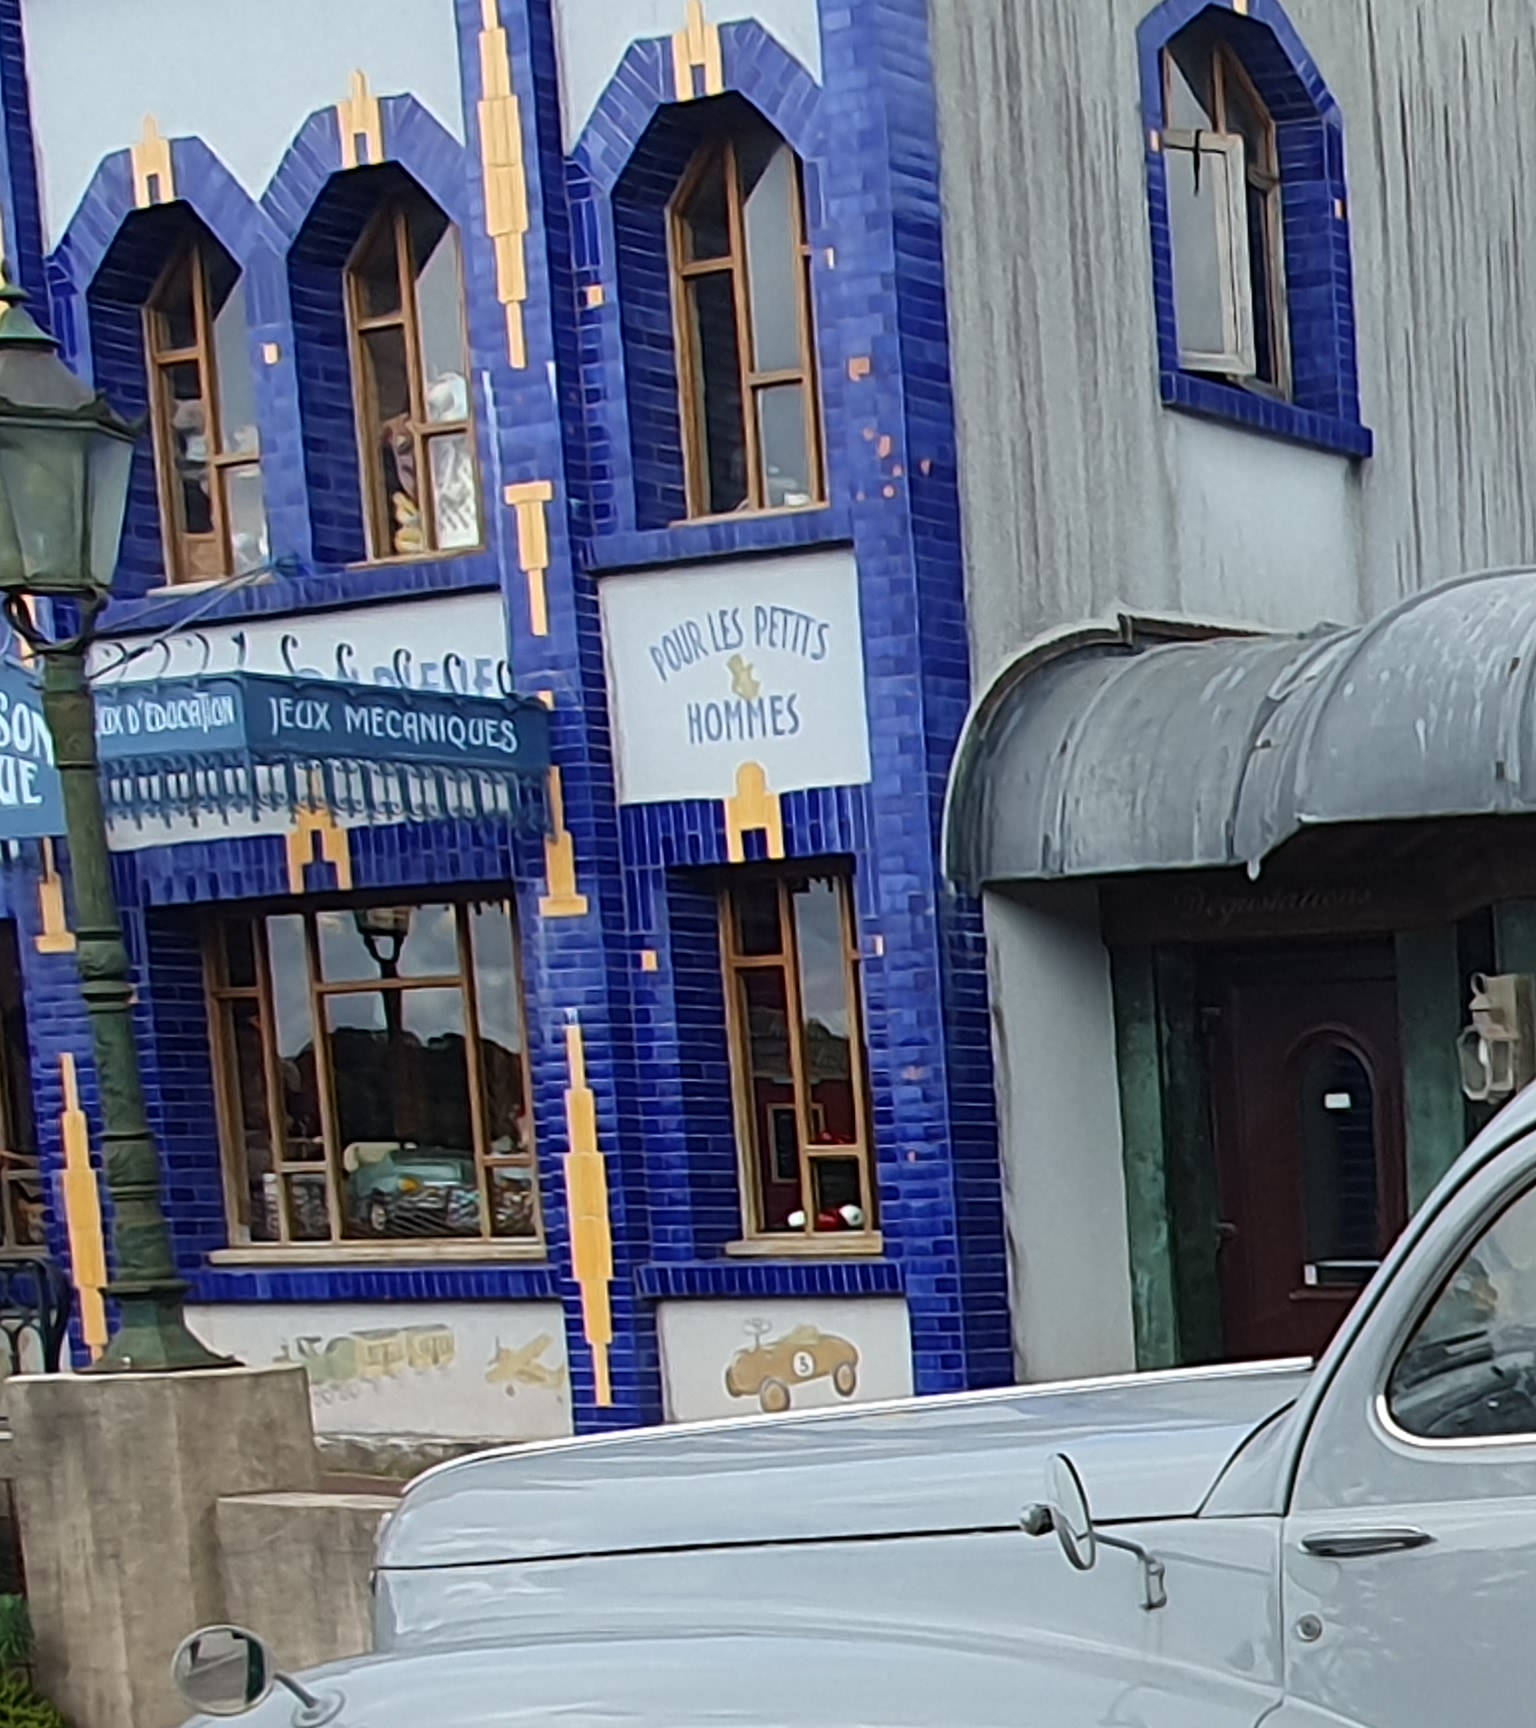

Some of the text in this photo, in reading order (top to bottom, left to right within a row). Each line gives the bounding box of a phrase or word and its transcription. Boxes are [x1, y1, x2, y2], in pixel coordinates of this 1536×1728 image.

[649, 605, 830, 682] POUR LES PETITS
[269, 697, 331, 735] JEUX
[686, 692, 800, 745] HOMMES
